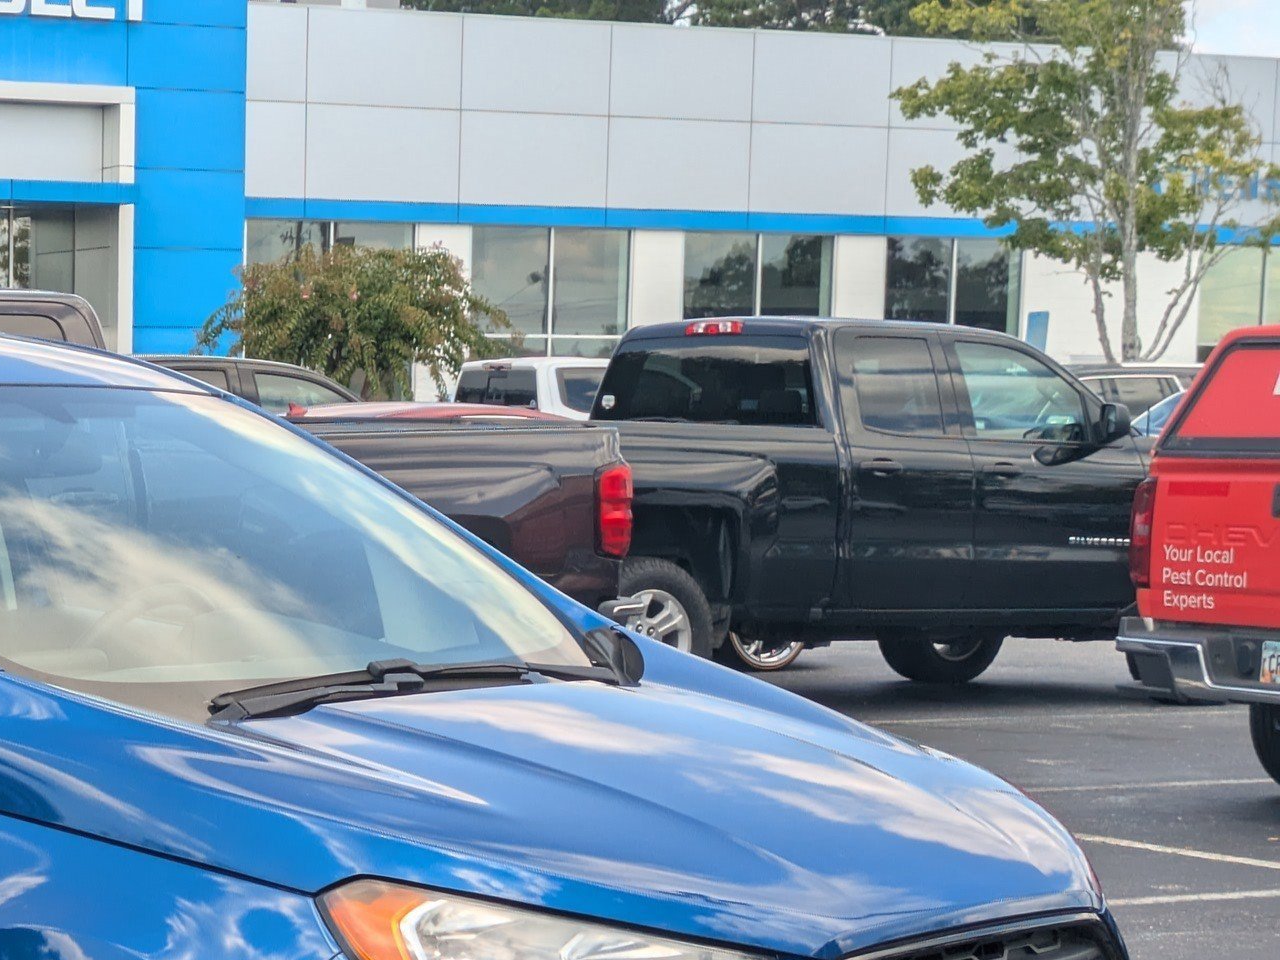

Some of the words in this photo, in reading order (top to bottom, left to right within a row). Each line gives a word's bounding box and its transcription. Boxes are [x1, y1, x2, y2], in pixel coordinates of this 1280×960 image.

[1163, 543, 1194, 562] Your
[1196, 544, 1235, 564] Local
[1162, 566, 1192, 586] Pest
[1194, 568, 1248, 588] Control
[1163, 589, 1216, 611] Experts
